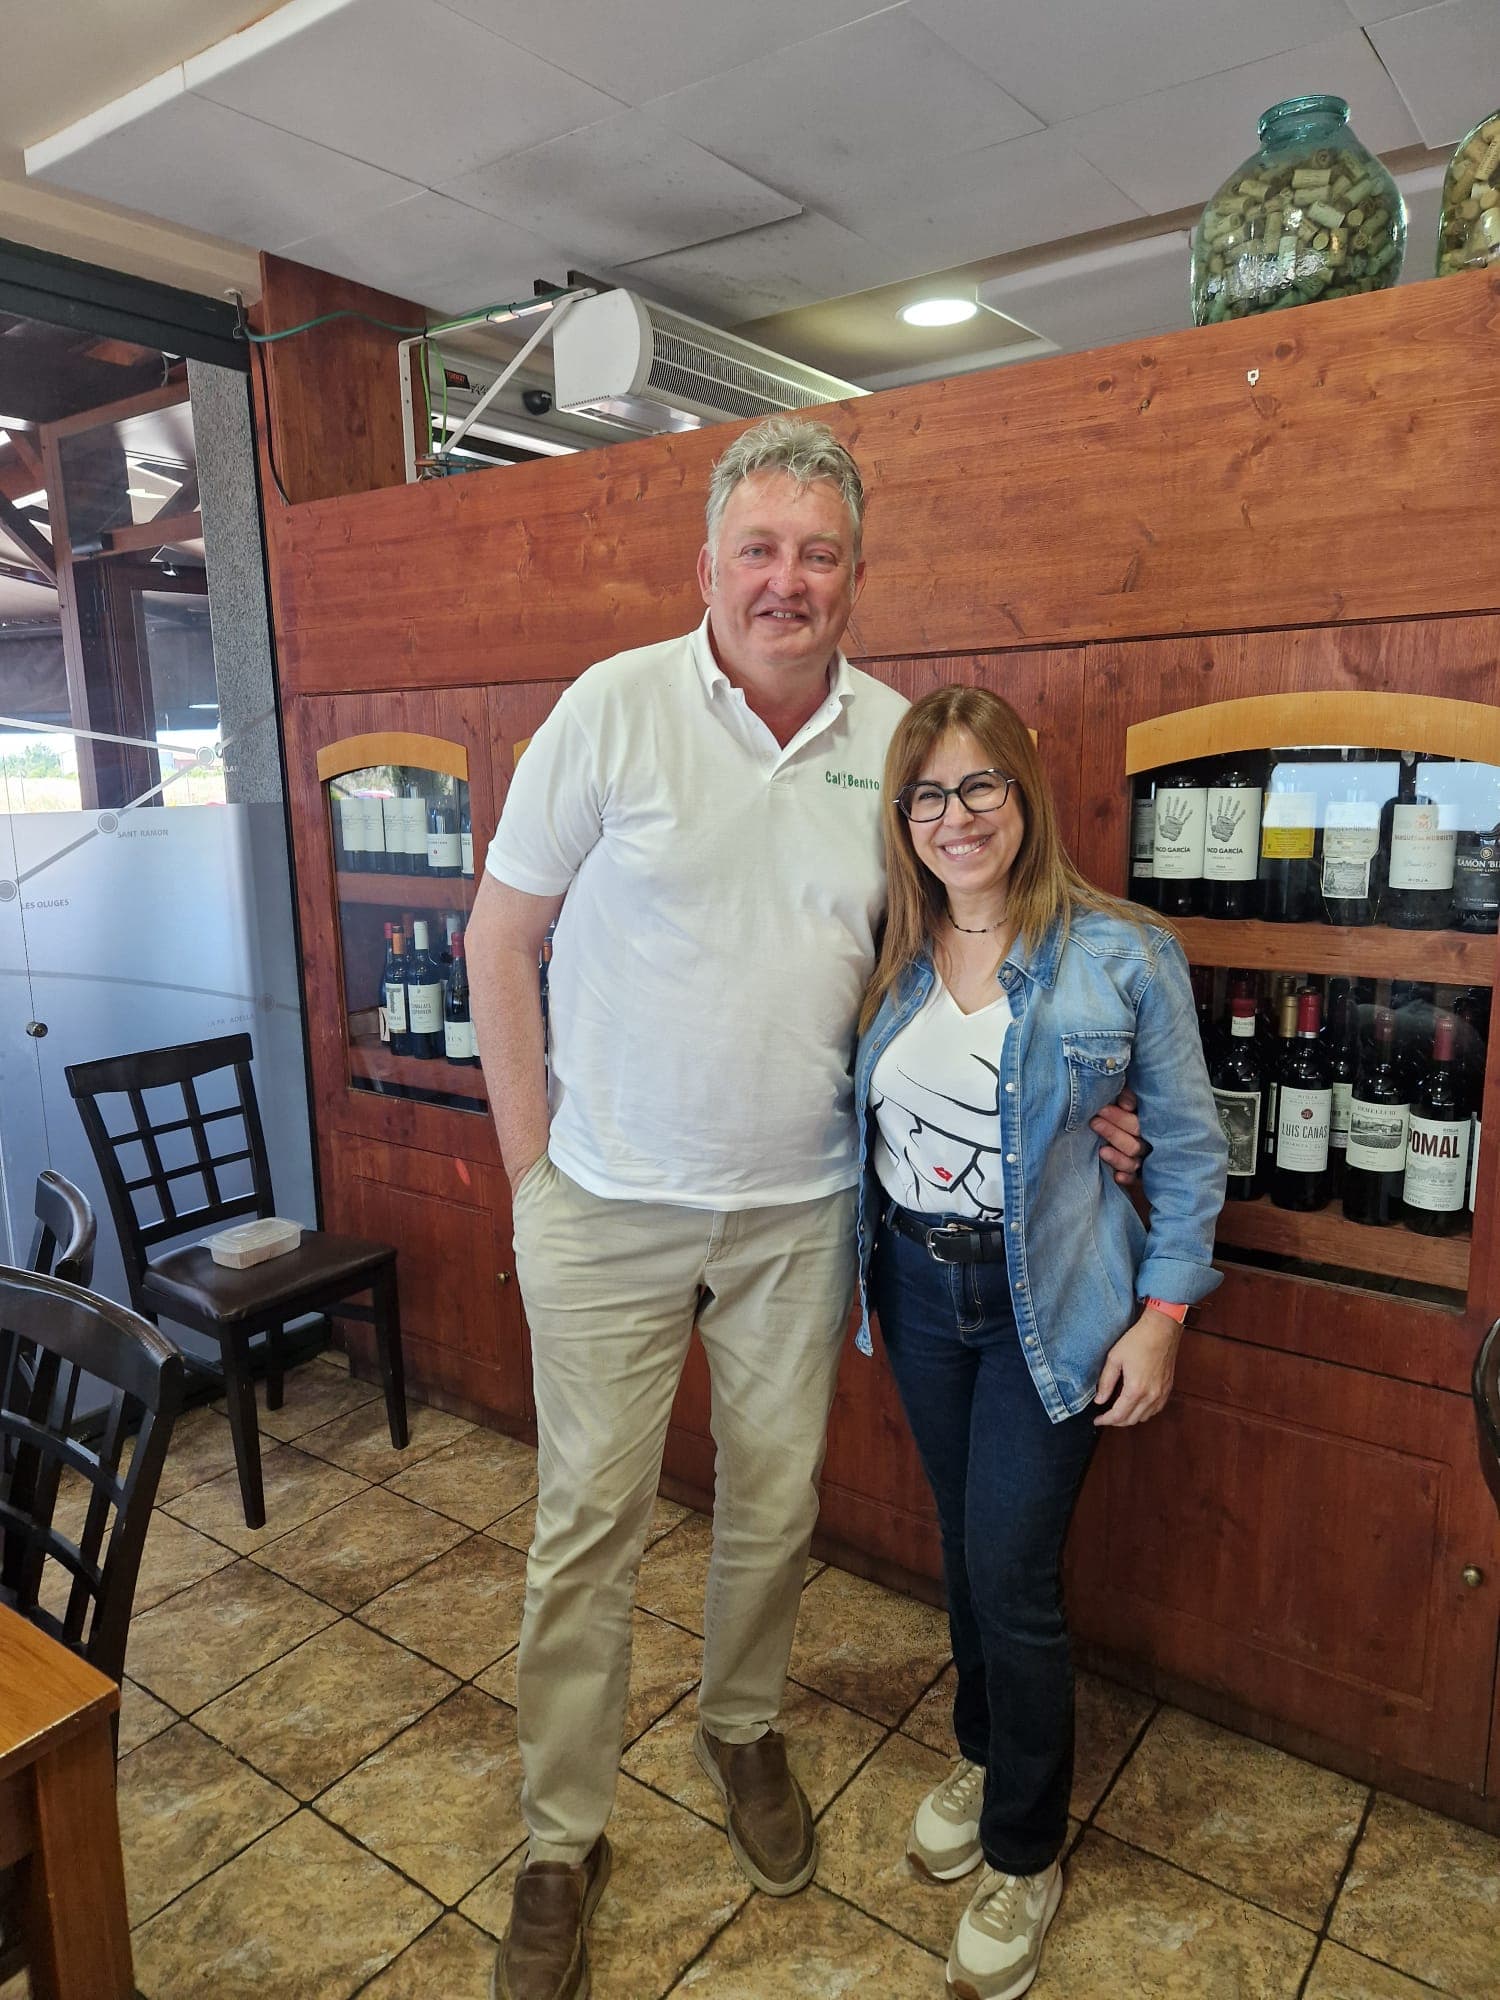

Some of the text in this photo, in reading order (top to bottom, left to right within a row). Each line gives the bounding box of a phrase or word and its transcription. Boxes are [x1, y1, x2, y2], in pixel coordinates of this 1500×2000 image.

[825, 770, 880, 790] Cal Benito
[117, 829, 169, 839] SANT RAMON
[21, 899, 70, 910] LES OLUGES
[1280, 1121, 1300, 1138] LUIS
